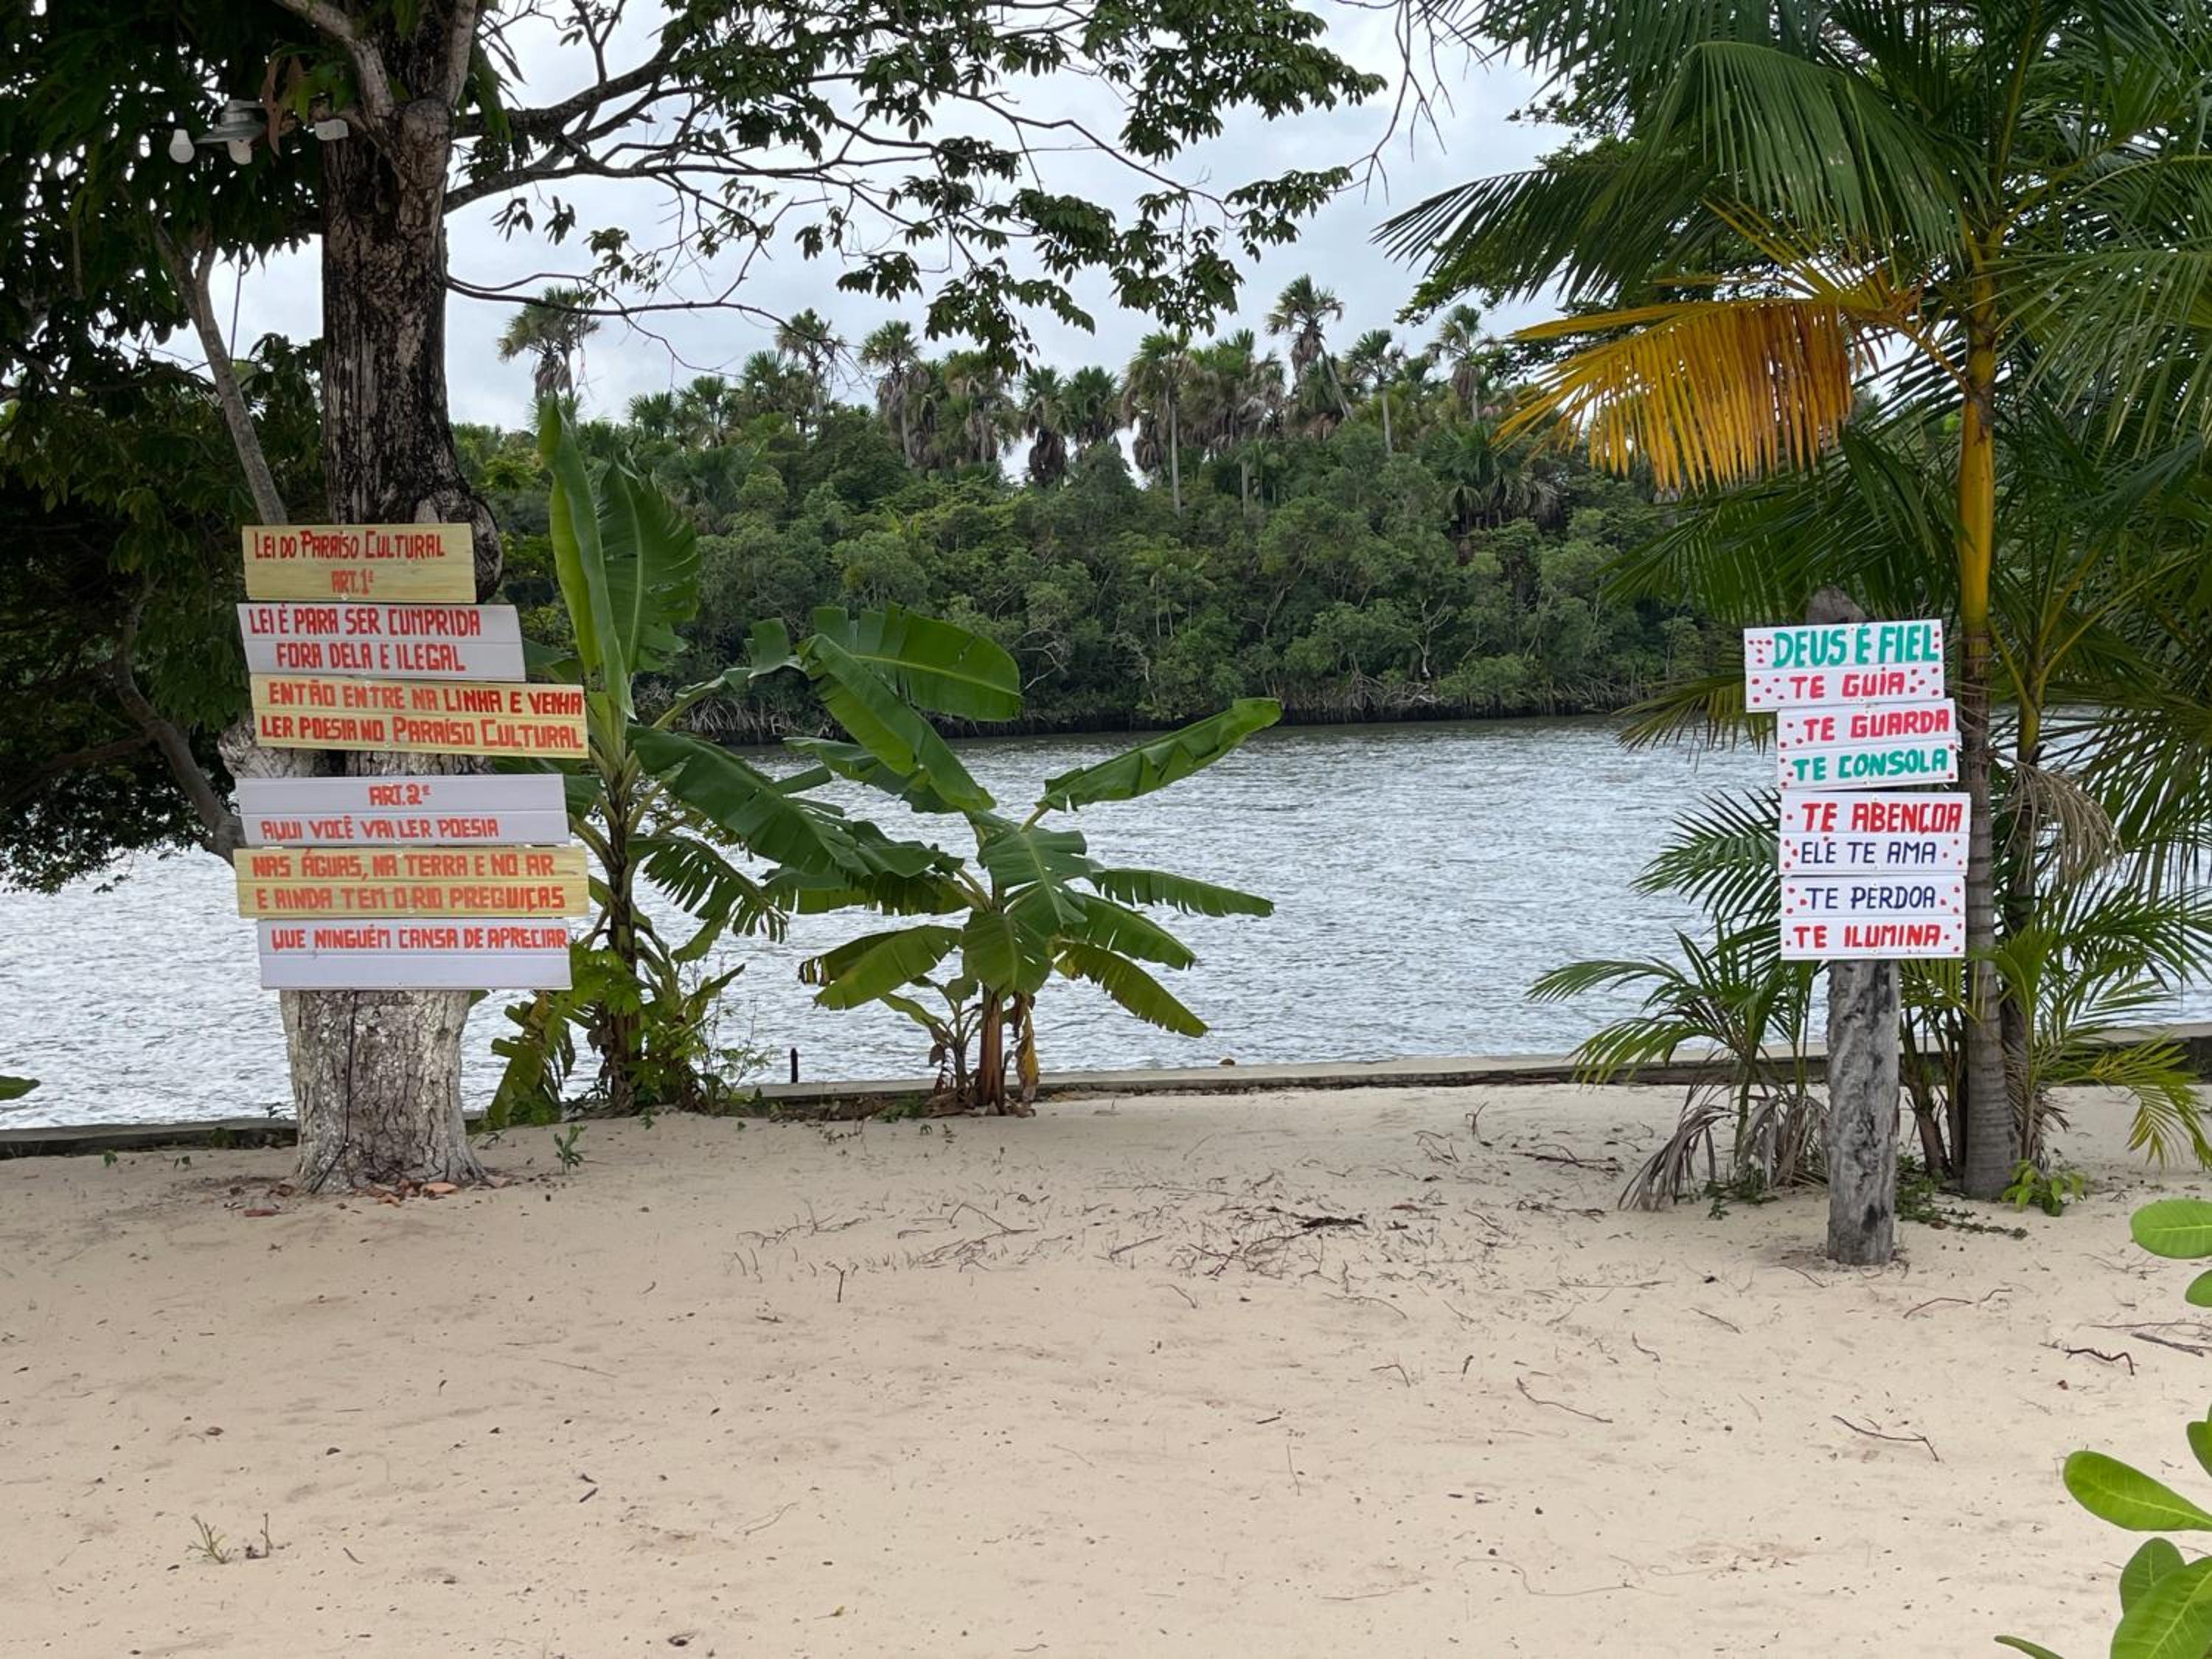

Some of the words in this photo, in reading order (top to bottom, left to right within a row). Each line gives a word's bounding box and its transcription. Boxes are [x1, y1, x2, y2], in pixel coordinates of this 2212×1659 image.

[279, 533, 296, 558] DO
[365, 531, 445, 560] CULTURAL
[249, 609, 274, 633] LEI
[279, 604, 289, 633] É
[295, 609, 339, 635] PARA
[345, 608, 381, 635] SER
[389, 608, 481, 636] CUMPRIDA
[276, 643, 323, 668] FORA
[329, 643, 373, 669] DELA
[380, 644, 389, 669] E
[396, 644, 467, 671] ILEGAL
[1773, 629, 1847, 668] DEUS
[1856, 623, 1871, 664] É
[1878, 625, 1939, 664] FIEL
[269, 679, 335, 707] ENTÃO
[343, 685, 405, 709] ENTRE
[411, 689, 437, 711] NA
[444, 689, 501, 713] LINHA
[509, 692, 522, 714] E
[527, 692, 582, 715] VENHA
[1790, 675, 1824, 699] TE
[261, 716, 293, 737] LER
[299, 717, 357, 740] POESIA
[358, 719, 385, 742] NO
[392, 716, 476, 746] PARAÍSO
[481, 719, 583, 749] CULTURAL
[1804, 717, 1834, 741] TE
[1850, 709, 1949, 738] GUARDA
[1792, 757, 1826, 781] TE
[1838, 749, 1947, 778] CONSOLA
[308, 816, 353, 839] VOCÊ
[360, 820, 394, 838] VAI
[397, 819, 433, 838] LER
[438, 818, 498, 838] POESIA
[1801, 802, 1837, 832] TE
[1851, 802, 1963, 835] ABENÇOA
[252, 856, 291, 877] NAS
[301, 849, 369, 880] ÁGUAS,
[372, 855, 397, 877] NA
[404, 855, 468, 877] TERRA
[475, 855, 485, 876] E
[490, 852, 518, 876] NO
[526, 855, 555, 876] AR
[1801, 842, 1836, 863] ELE
[1847, 842, 1876, 863] TE
[1887, 842, 1936, 863] AMA
[255, 889, 267, 909] E
[274, 888, 333, 909] AINDA
[340, 888, 388, 909] TEM
[394, 888, 408, 909] O
[411, 888, 442, 909] RIO
[450, 886, 566, 913] PREGUIÇAS
[1805, 888, 1838, 909] TE
[1851, 886, 1935, 909] PERDOA
[313, 924, 391, 949] NINGUÉM
[399, 928, 458, 949] CANSA
[464, 928, 484, 949] DE
[488, 927, 568, 949] APRECIAR
[1793, 926, 1827, 948] TE
[1844, 925, 1941, 947] ILUMINA
